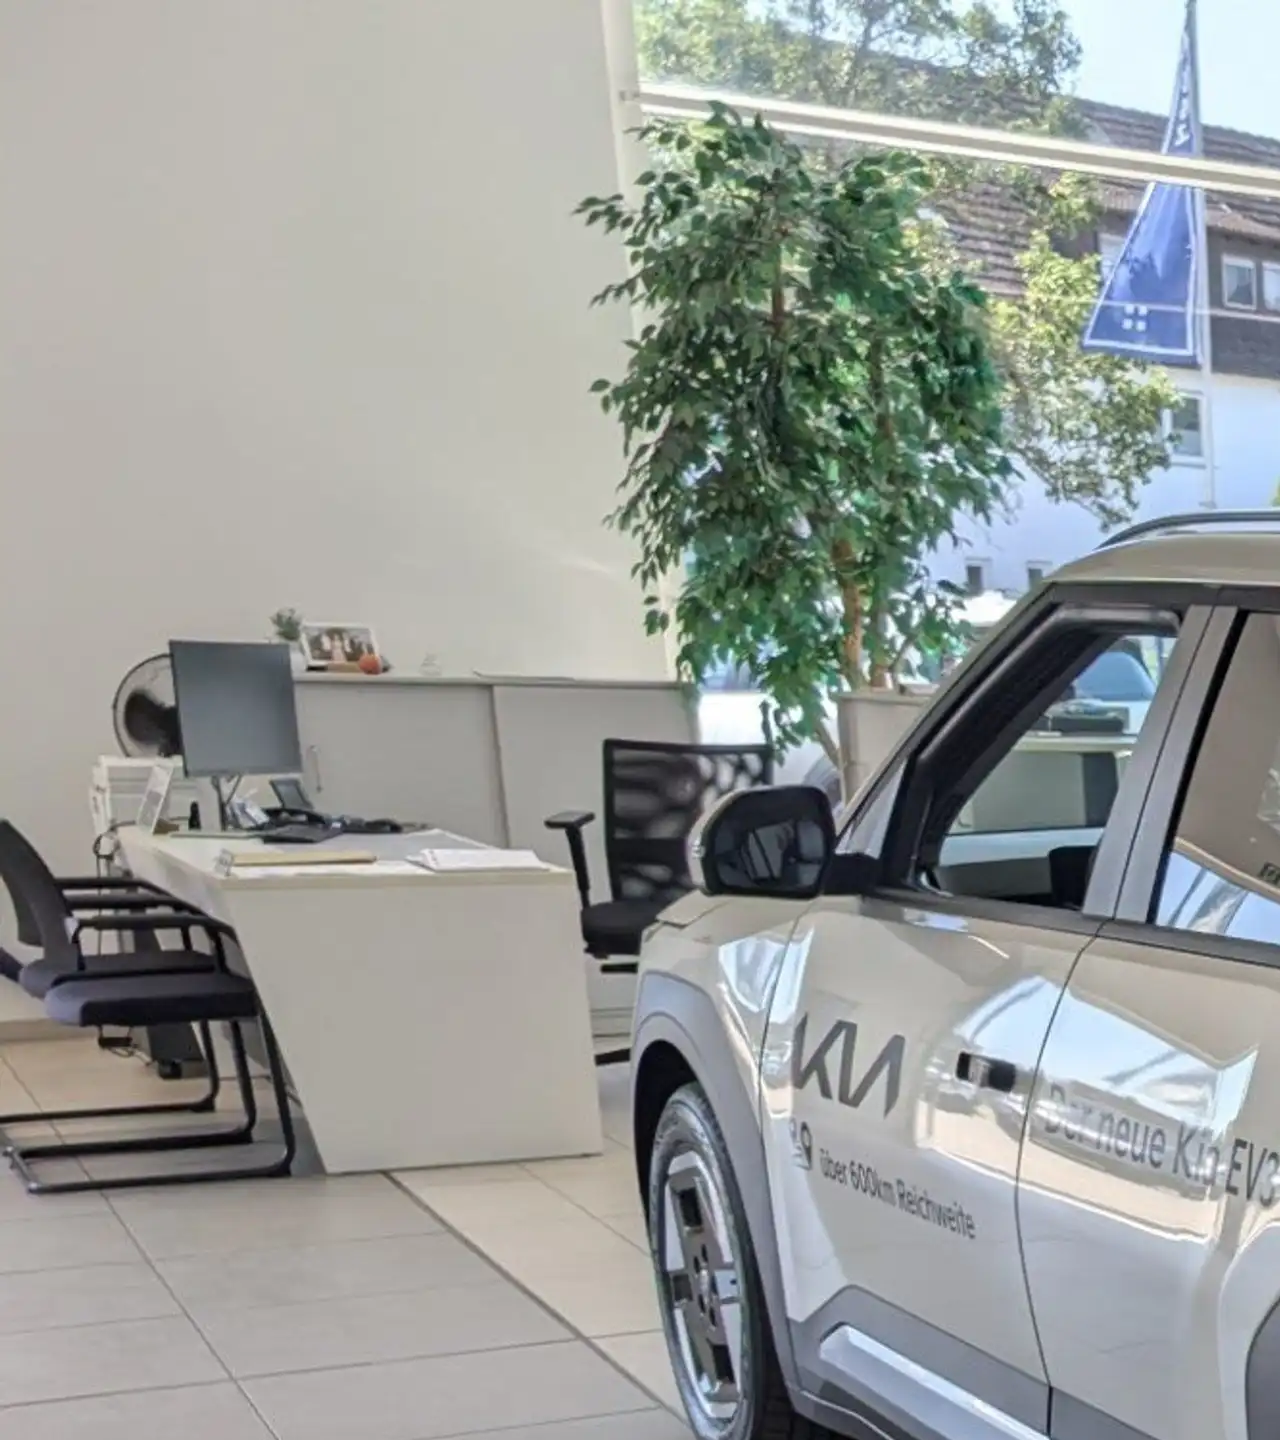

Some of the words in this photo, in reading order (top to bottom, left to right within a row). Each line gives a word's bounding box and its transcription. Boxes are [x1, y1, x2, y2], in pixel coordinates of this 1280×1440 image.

[791, 1012, 905, 1120] KIA
[850, 1161, 897, 1207] 600km
[897, 1180, 977, 1240] Reichweite
[1096, 1112, 1166, 1169] neue
[1172, 1121, 1220, 1187] Kia
[1225, 1137, 1280, 1207] EV3
